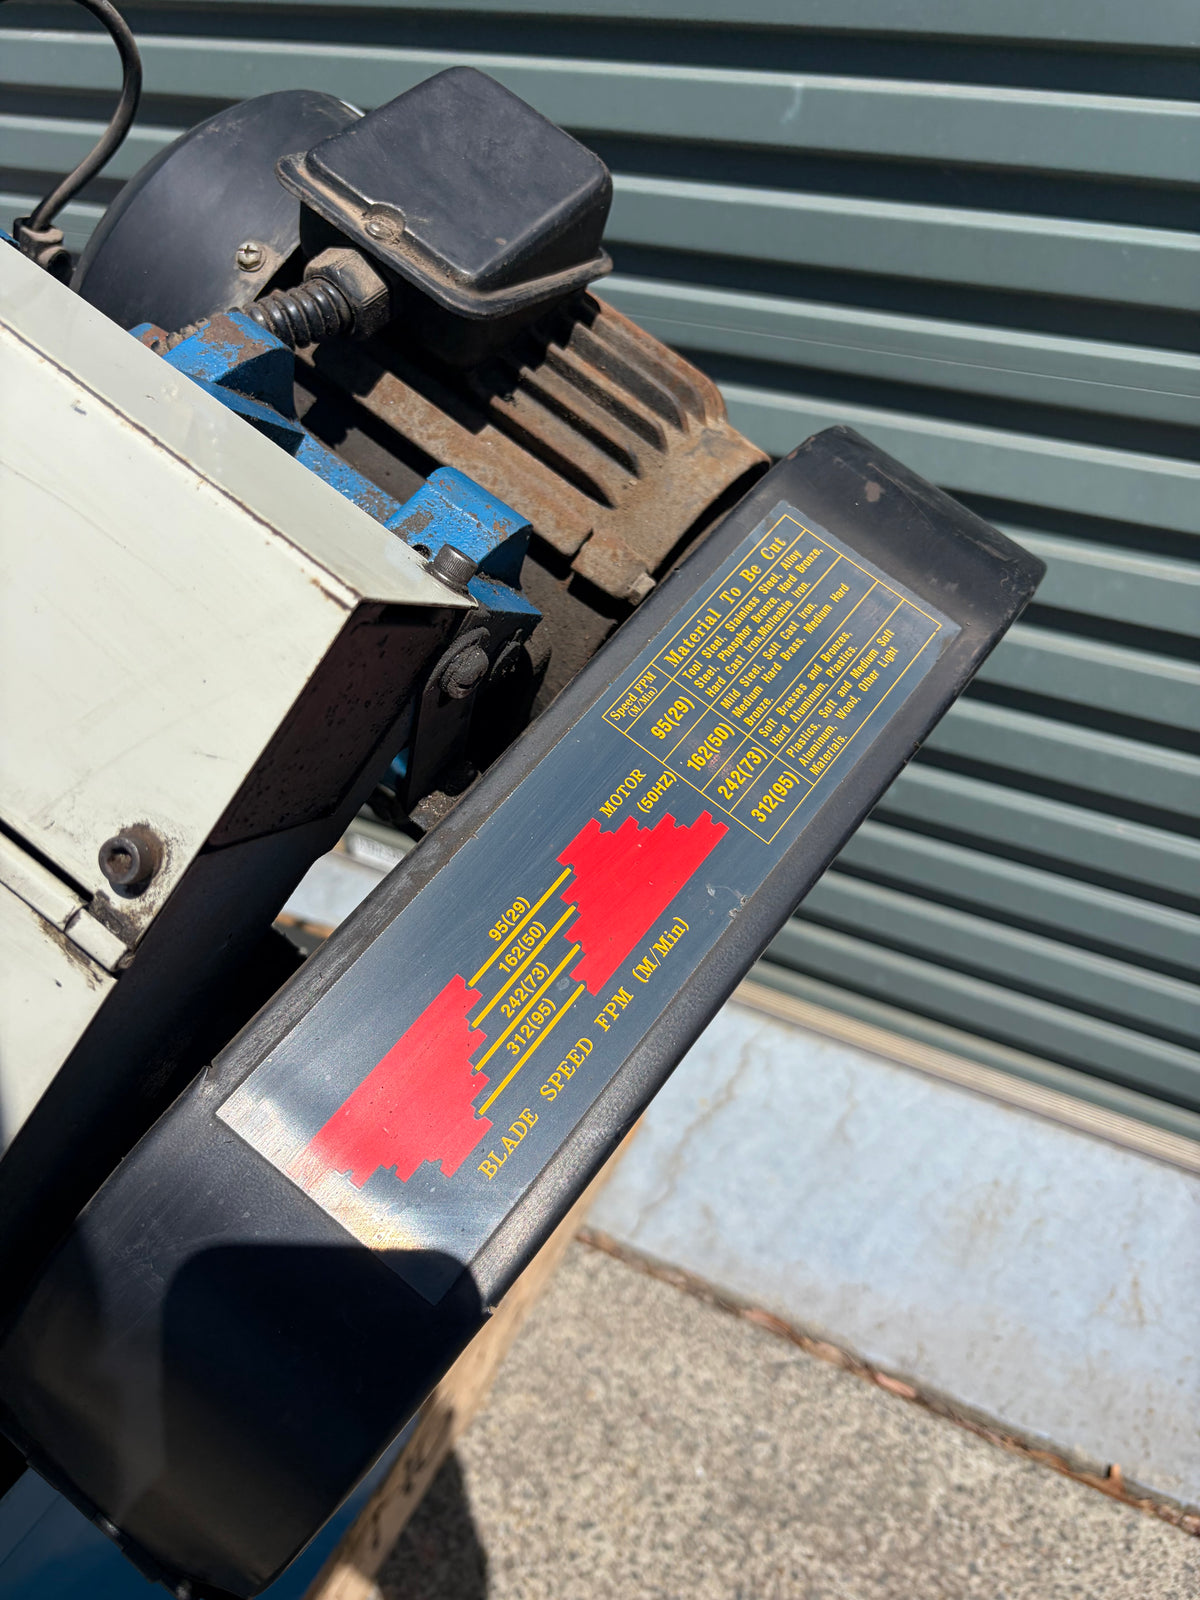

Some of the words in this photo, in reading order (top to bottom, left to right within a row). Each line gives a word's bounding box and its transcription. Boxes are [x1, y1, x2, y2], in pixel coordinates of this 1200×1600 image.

[663, 607, 722, 668] Material
[718, 587, 742, 605] To
[738, 564, 762, 584] Be
[759, 537, 787, 561] Cut
[681, 659, 703, 680] Tool
[700, 635, 728, 660] Steel,
[724, 596, 761, 633] Stainless
[757, 572, 783, 595] Steel,
[779, 549, 803, 572] Alloy
[693, 664, 720, 690] Steel,
[716, 625, 753, 663] Phosphor
[750, 596, 781, 624] Bronze,
[776, 573, 798, 594] Hard
[794, 548, 824, 574] Bronze,
[704, 675, 727, 698] Hard
[724, 654, 746, 676] Cast
[790, 582, 811, 599] Iron.
[719, 688, 741, 710] Mild
[738, 663, 766, 688] Steel,
[761, 641, 782, 661] Soft
[779, 620, 800, 641] Cast
[796, 603, 818, 620] Iron,
[731, 685, 764, 719] Medium
[760, 661, 783, 684] Hard
[779, 637, 807, 662] Brass,
[802, 604, 833, 635] Medium
[829, 582, 850, 604] Hard
[609, 692, 642, 722] Speed
[633, 671, 657, 695] FPM
[627, 686, 658, 718] (M/Min)
[742, 697, 774, 727] Bronze.
[757, 717, 778, 738] Soft
[775, 683, 808, 717] Brasses
[806, 663, 823, 682] and
[819, 632, 853, 664] Bronzes,
[768, 723, 791, 747] Hard
[788, 682, 829, 724] Aluminum,
[824, 646, 858, 679] Plastics.
[785, 723, 822, 759] Plastics,
[817, 698, 838, 719] Soft
[836, 679, 853, 698] and
[849, 648, 879, 680] Medium
[875, 628, 895, 648] Soft
[797, 725, 838, 768] Aluminum,
[833, 695, 862, 721] Wood,
[857, 669, 880, 693] Other
[876, 646, 899, 669] Light
[650, 696, 695, 740] 95(29)
[686, 722, 736, 772] 162(50)
[716, 746, 768, 801] 242(73)
[808, 735, 848, 777] Materials.
[598, 769, 647, 819] MOTOR
[636, 770, 677, 814] (50HZ)
[750, 770, 800, 823] 312(95)
[488, 896, 531, 942] 95(29)
[498, 921, 547, 973] 162(50)
[500, 962, 550, 1019] 242(73)
[477, 1107, 539, 1181] BLADE
[539, 1037, 594, 1102] SPEED
[593, 986, 634, 1033] FPM
[631, 916, 690, 984] (M/Min)
[505, 998, 557, 1056] 312(95)
